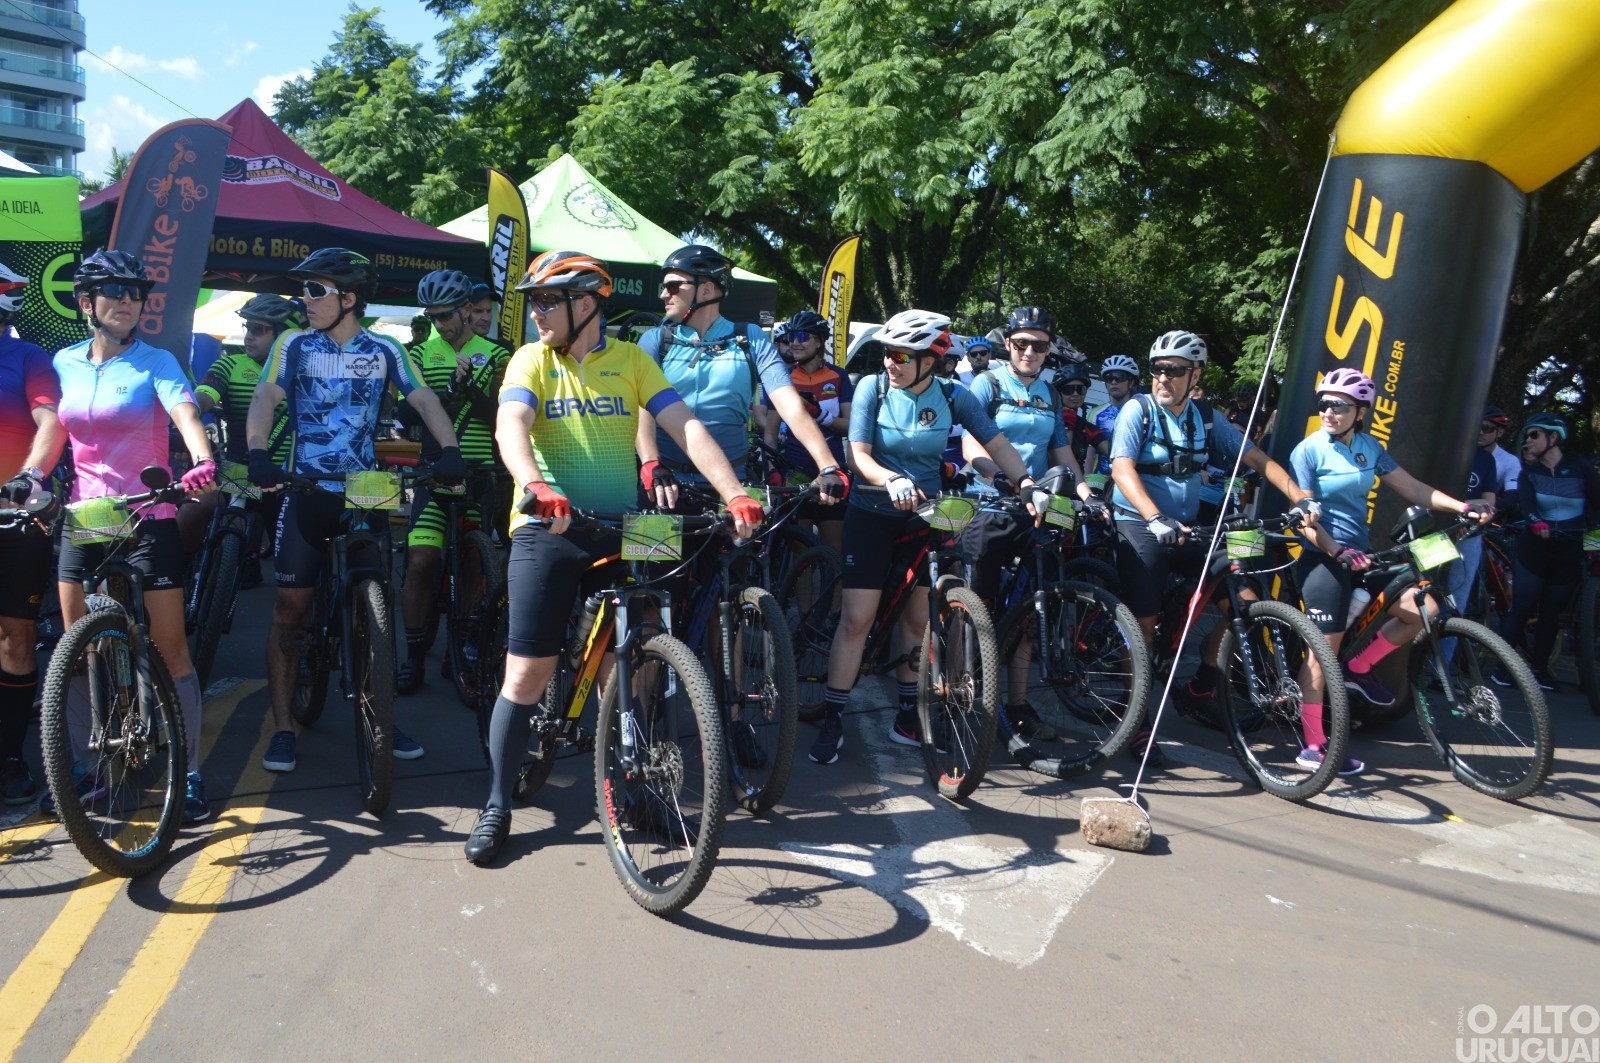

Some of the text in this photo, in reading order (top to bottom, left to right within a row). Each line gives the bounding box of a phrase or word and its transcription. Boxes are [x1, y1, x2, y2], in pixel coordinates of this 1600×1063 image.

[246, 158, 335, 190] BARRIL
[12, 200, 44, 214] IDEIA.
[143, 214, 179, 283] Bike
[209, 234, 310, 259] oto & Bike
[492, 220, 514, 300] RRIL
[375, 253, 395, 268] (55)
[397, 256, 448, 270] 3744-6681
[502, 231, 521, 340] MOTO & BIKE
[345, 363, 380, 371] MARRETA'S
[545, 396, 631, 419] BRASIL
[267, 414, 289, 449] ARTARUGAS
[1272, 629, 1290, 676] MANITO
[578, 678, 592, 700] 7.2
[603, 778, 626, 851] ALEXRIMS
[626, 877, 653, 901] KENDA
